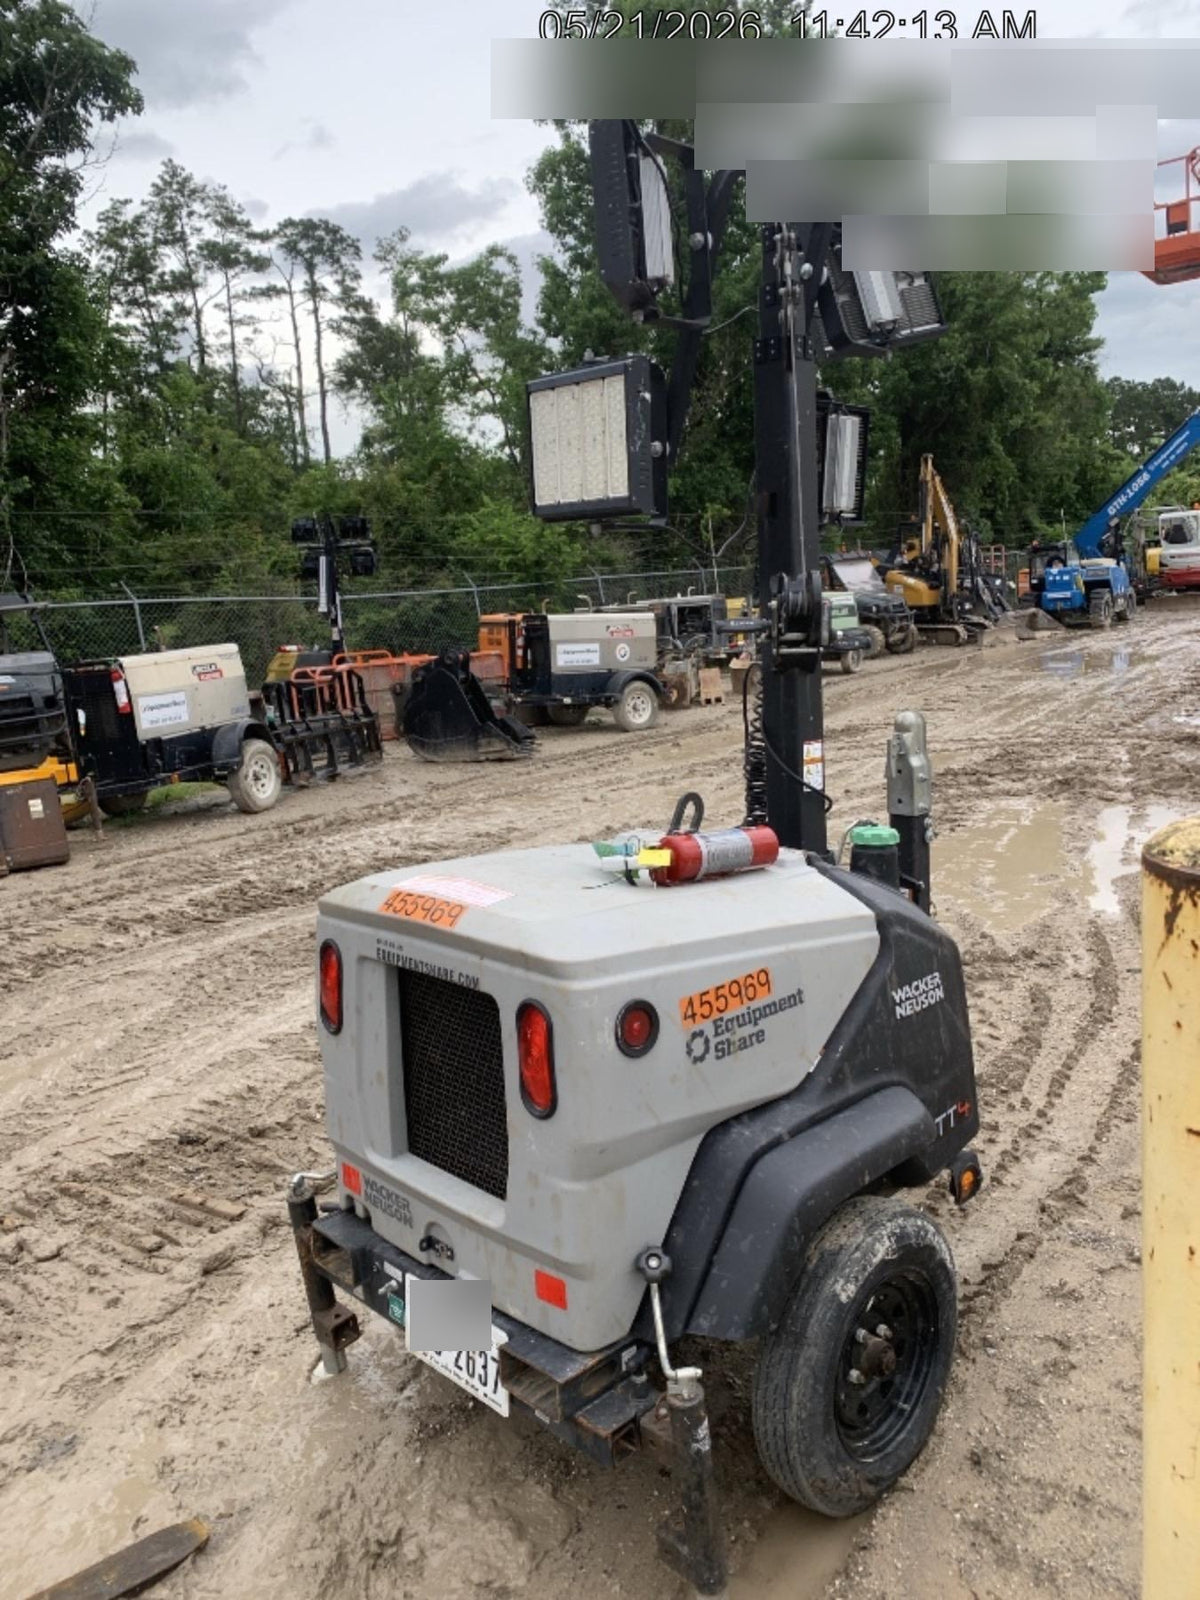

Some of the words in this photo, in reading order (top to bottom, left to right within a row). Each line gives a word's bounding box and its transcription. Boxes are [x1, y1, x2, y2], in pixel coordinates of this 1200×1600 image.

[383, 890, 464, 928] 455969
[683, 967, 772, 1025] 455969
[891, 971, 942, 1004] WACKER
[894, 986, 945, 1020] NEUSON
[711, 987, 805, 1038] Equipment
[714, 1028, 766, 1061] Share
[363, 1176, 411, 1216] WACKER
[364, 1188, 414, 1230] NEUSON
